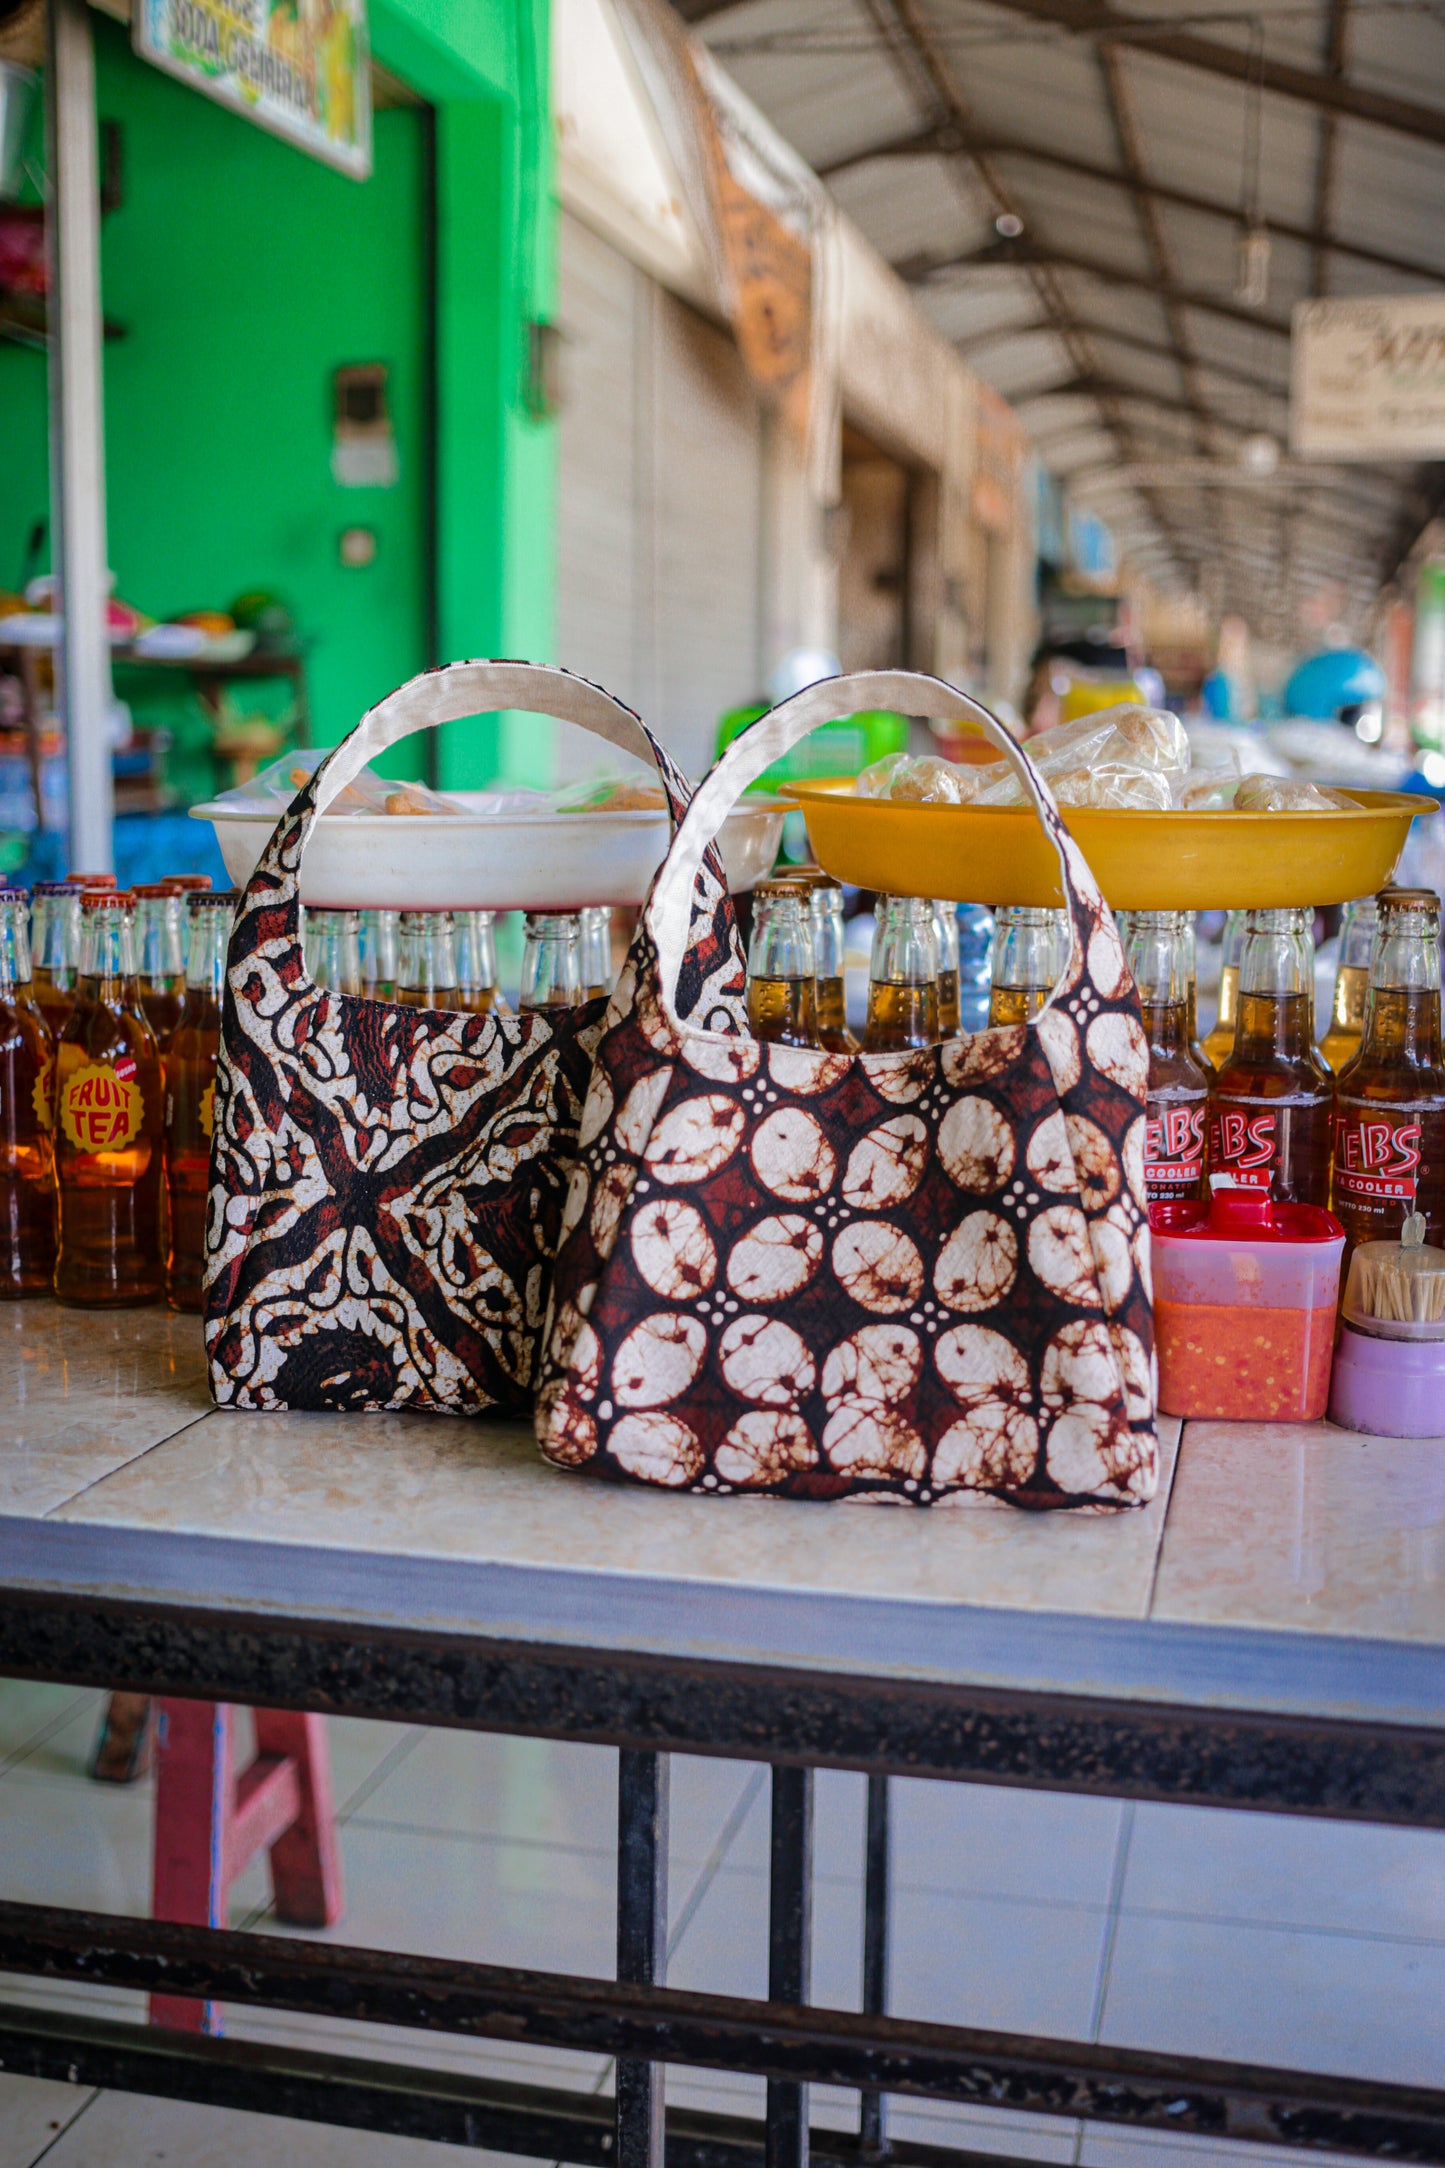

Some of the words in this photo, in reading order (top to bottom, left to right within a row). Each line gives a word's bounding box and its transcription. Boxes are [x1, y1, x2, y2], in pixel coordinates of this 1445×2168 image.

[69, 1077, 131, 1108] FRUIT
[69, 1109, 129, 1144] TEA
[1143, 1106, 1206, 1162] EBS
[1210, 1111, 1276, 1168] EBS
[1146, 1166, 1196, 1178] COOLER
[1348, 1179, 1404, 1195] COOLER
[1358, 1203, 1372, 1213] 230
[1373, 1205, 1385, 1214] ml
